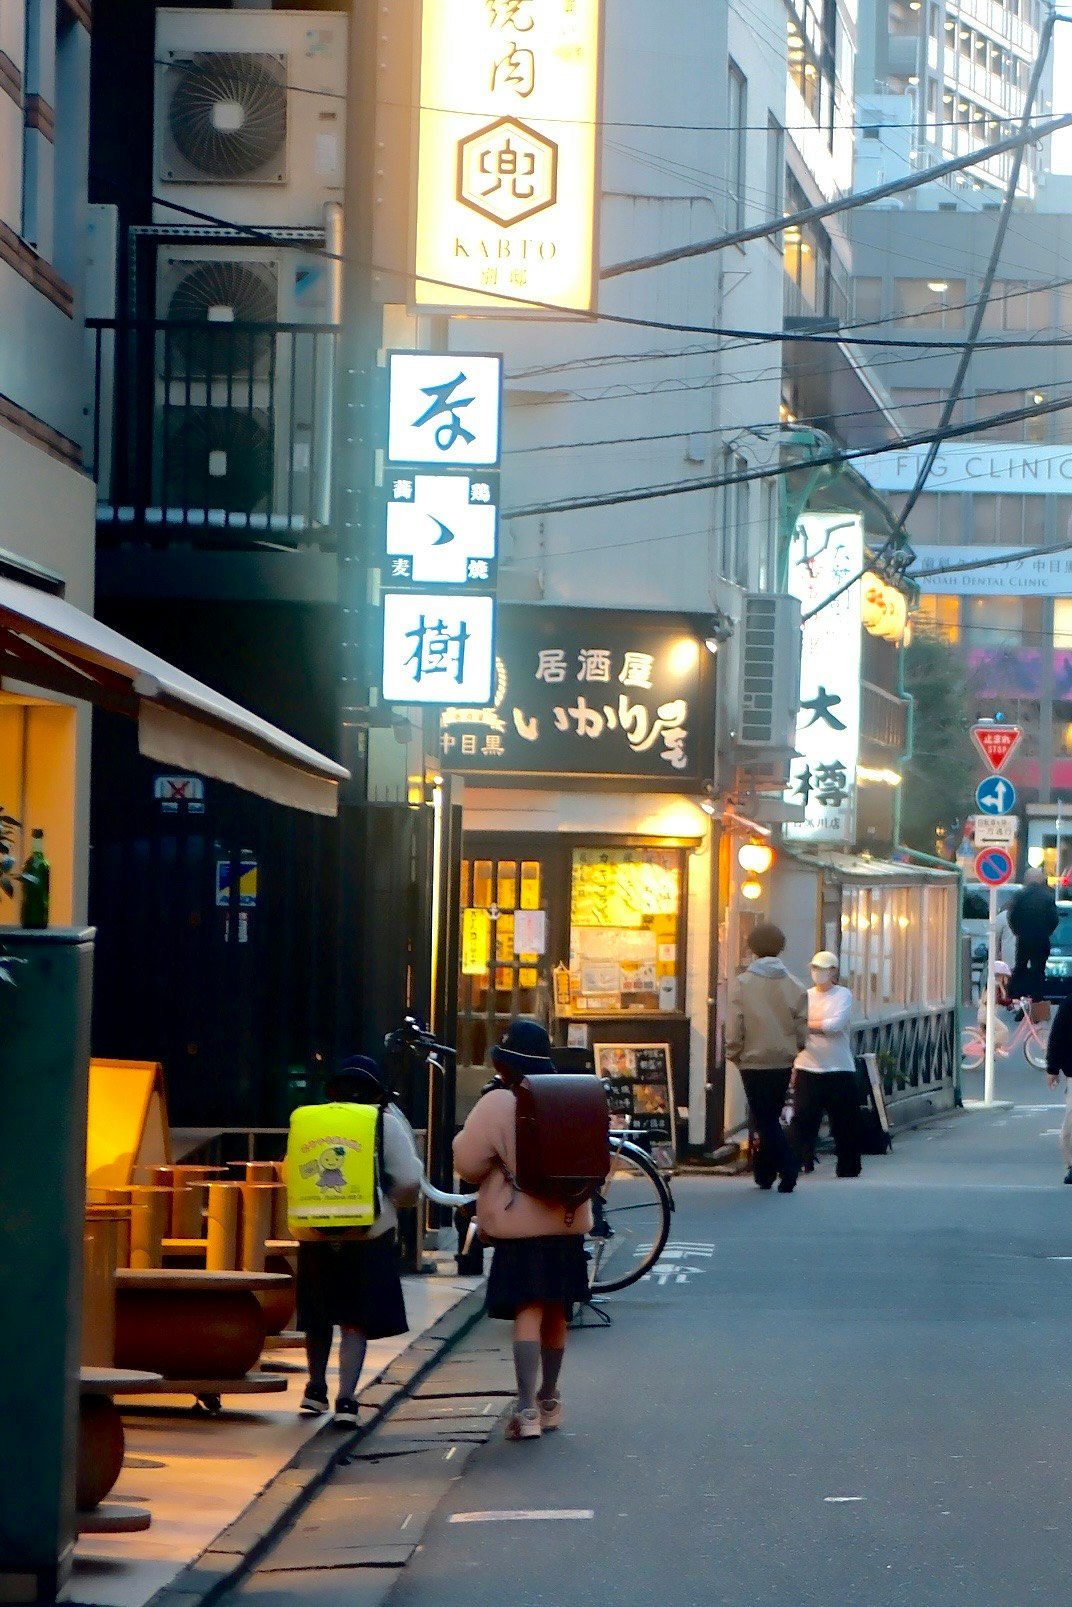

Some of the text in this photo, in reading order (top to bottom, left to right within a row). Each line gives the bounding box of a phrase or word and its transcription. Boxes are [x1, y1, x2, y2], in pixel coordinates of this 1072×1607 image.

[479, 138, 535, 198] 兜
[896, 456, 948, 478] FIG
[535, 648, 654, 690] 居酒屋
[513, 693, 688, 769] いかり屋
[984, 734, 1010, 744] 止まれ
[440, 732, 505, 756] 中目黒
[988, 745, 1007, 754] STOP
